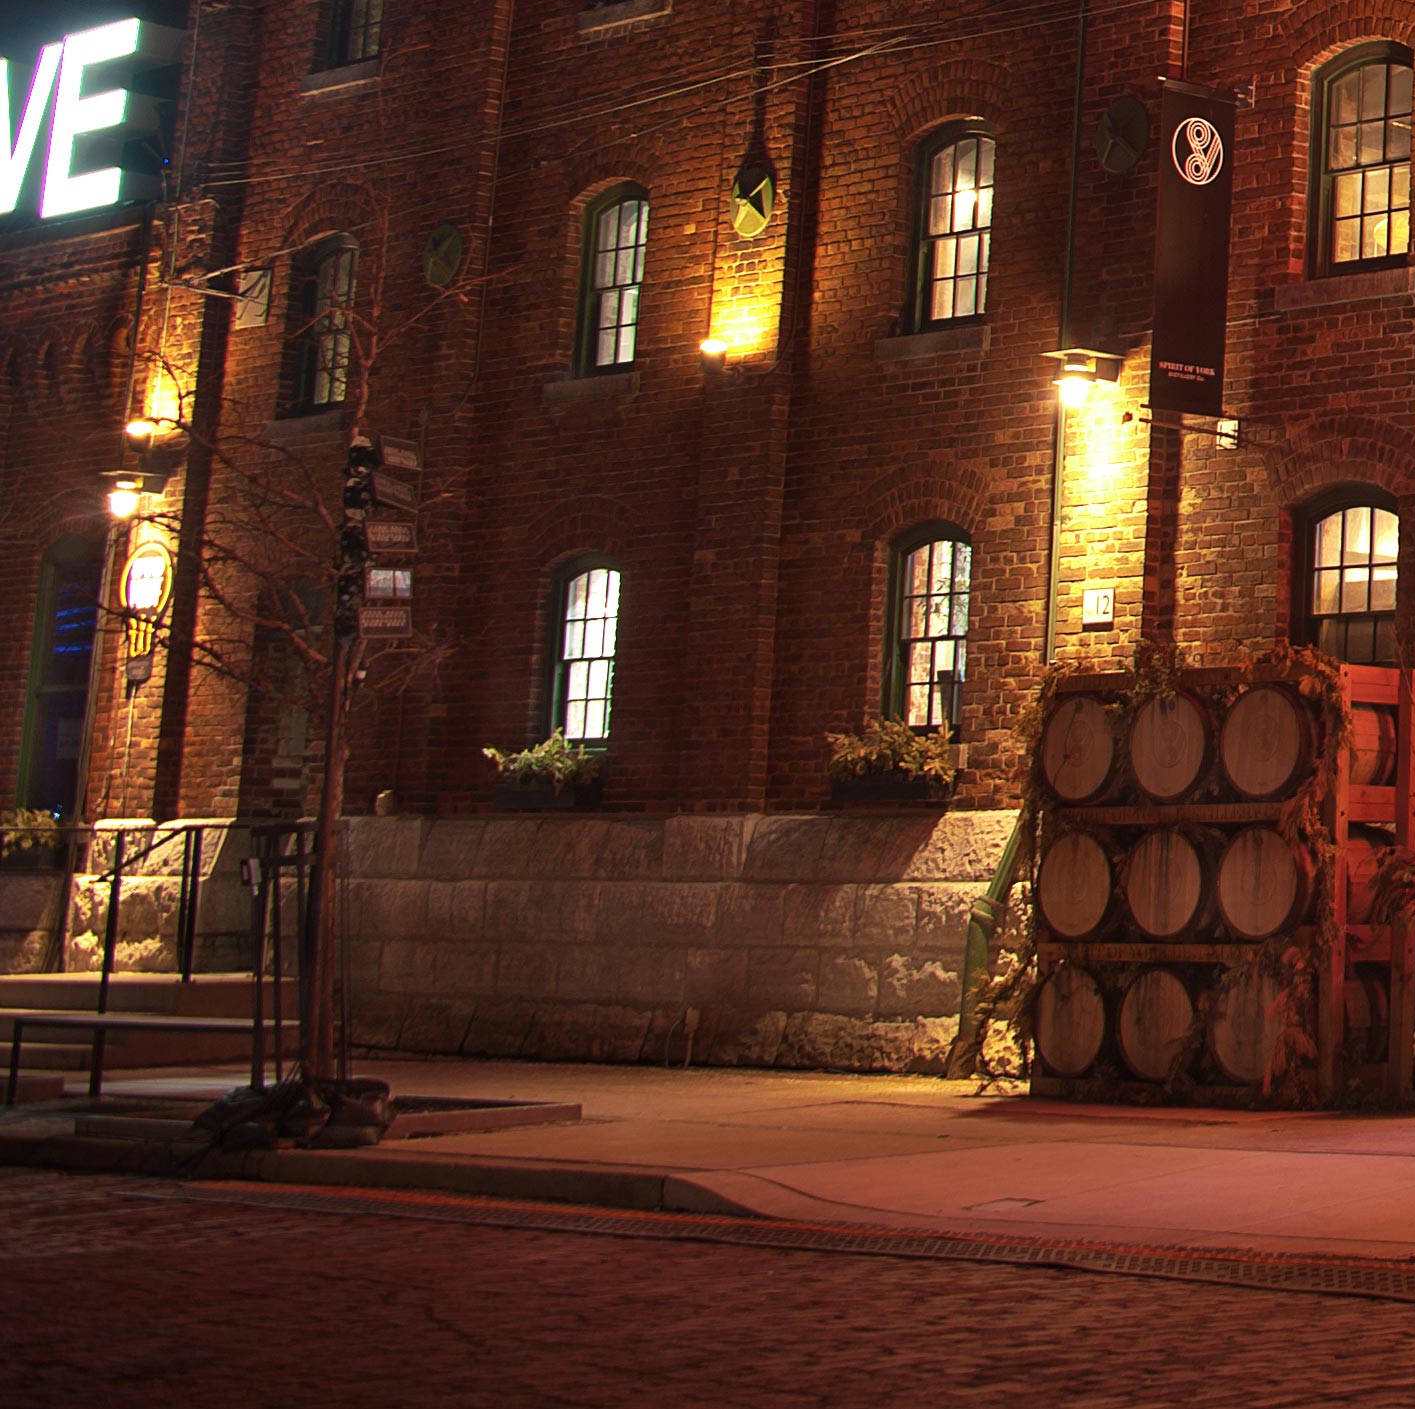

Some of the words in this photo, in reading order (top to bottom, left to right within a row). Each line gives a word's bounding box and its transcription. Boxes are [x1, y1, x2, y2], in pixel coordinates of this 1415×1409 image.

[1159, 361, 1184, 372] SPIRIT
[1196, 366, 1216, 376] YORK
[1096, 594, 1110, 615] 12
